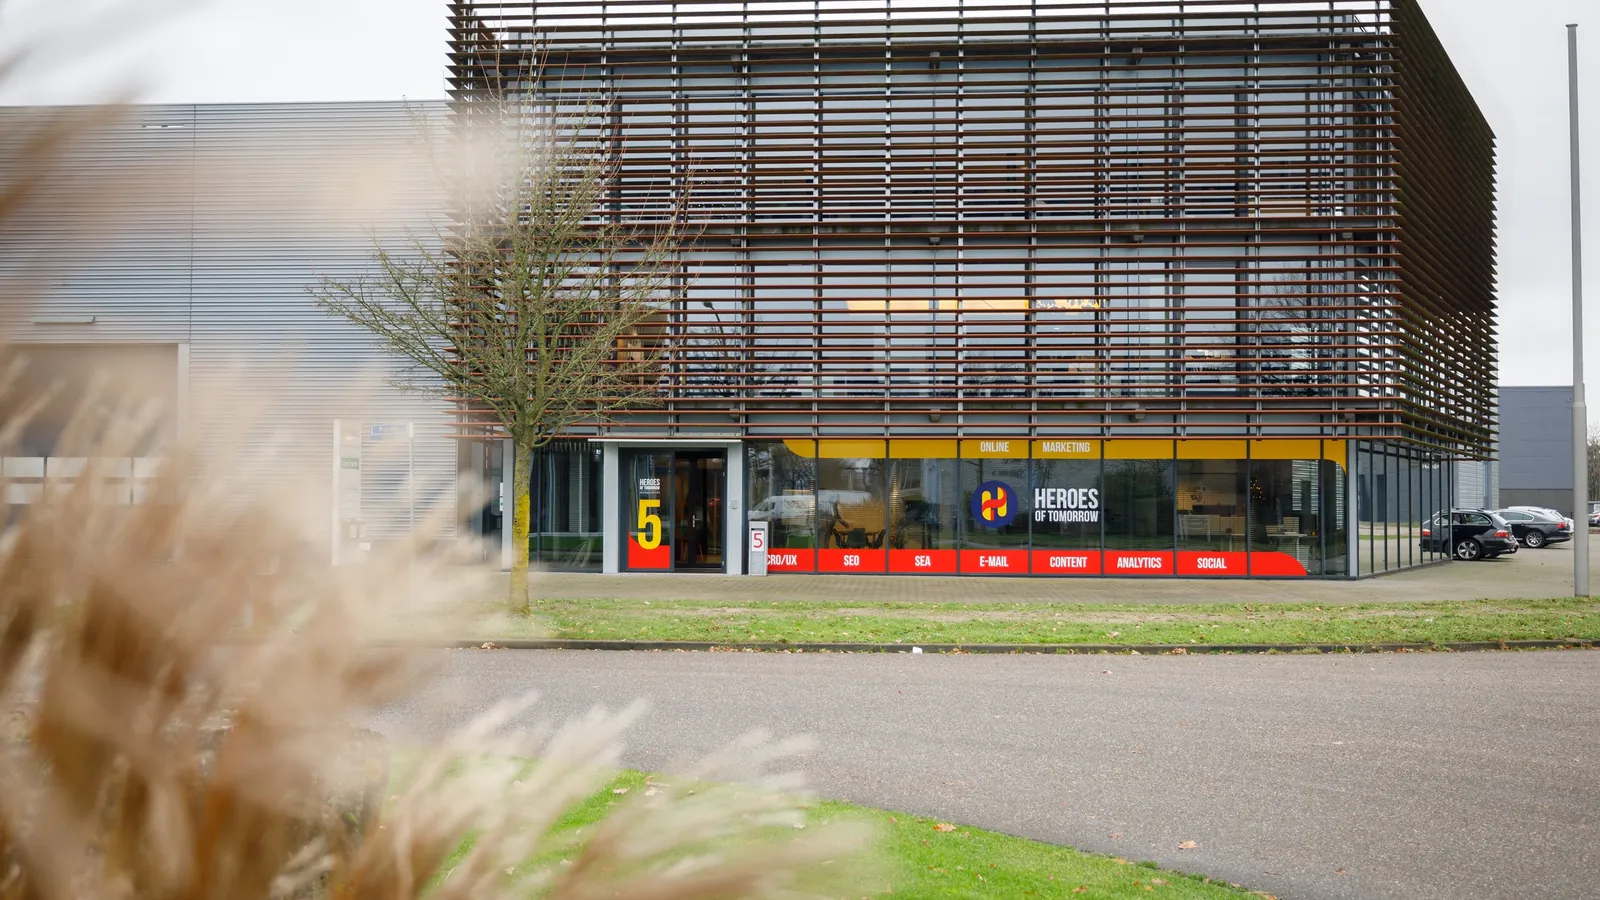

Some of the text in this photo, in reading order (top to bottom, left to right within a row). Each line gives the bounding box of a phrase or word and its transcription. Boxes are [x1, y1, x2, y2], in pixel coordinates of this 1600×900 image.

[980, 442, 1090, 453] ONLINE MARKETING
[639, 478, 660, 486] HEROES
[1034, 488, 1098, 509] HEROES
[1035, 510, 1098, 522] OF TOMORROW
[637, 499, 662, 550] 5
[753, 532, 763, 548] 5
[843, 555, 860, 566] SEO
[914, 555, 931, 567] SEA
[979, 556, 1009, 567] E-MAIL
[1049, 556, 1088, 568] CONTENT
[1116, 557, 1162, 569] ANALYTICS
[1197, 557, 1227, 569] SOCIAL
